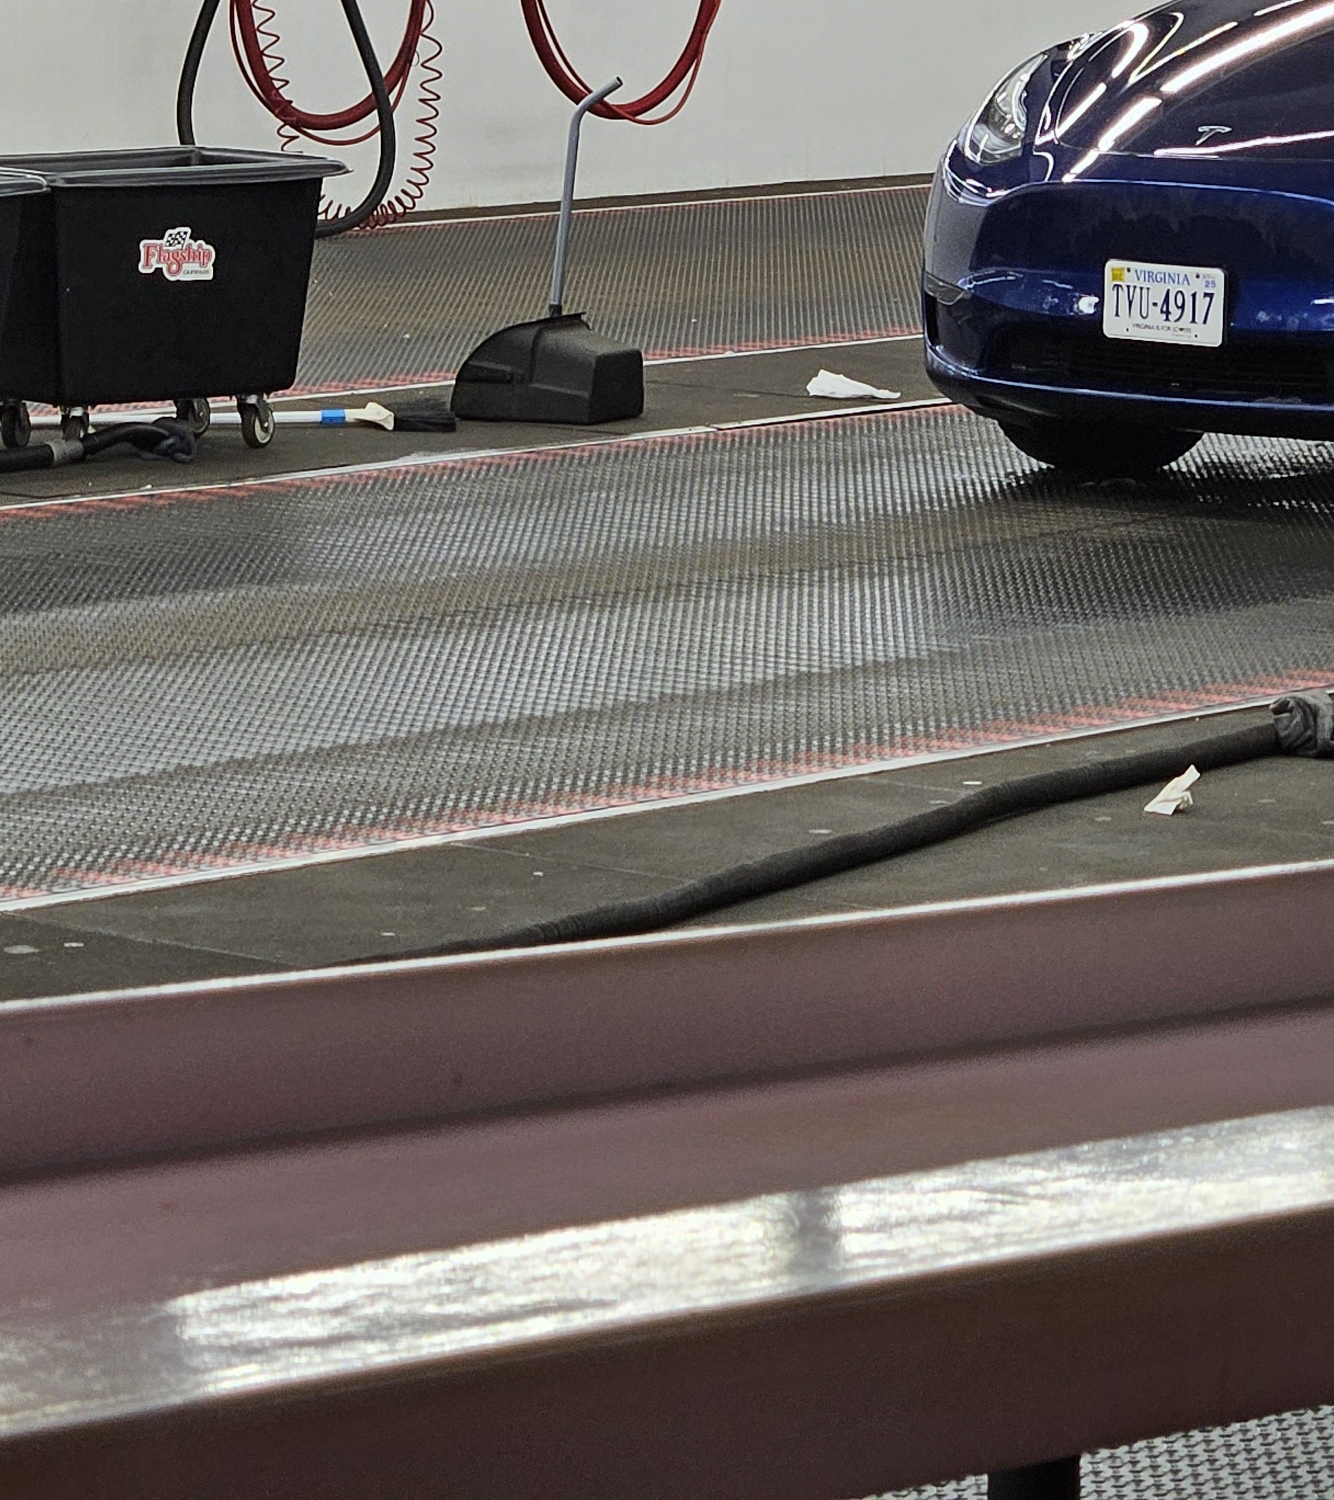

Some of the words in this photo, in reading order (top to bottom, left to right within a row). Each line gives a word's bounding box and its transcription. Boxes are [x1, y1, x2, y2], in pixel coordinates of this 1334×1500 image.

[143, 243, 212, 276] Flagship
[1134, 269, 1191, 286] VIRGINIA
[1204, 280, 1216, 288] 25
[1112, 284, 1215, 325] TVU-4917
